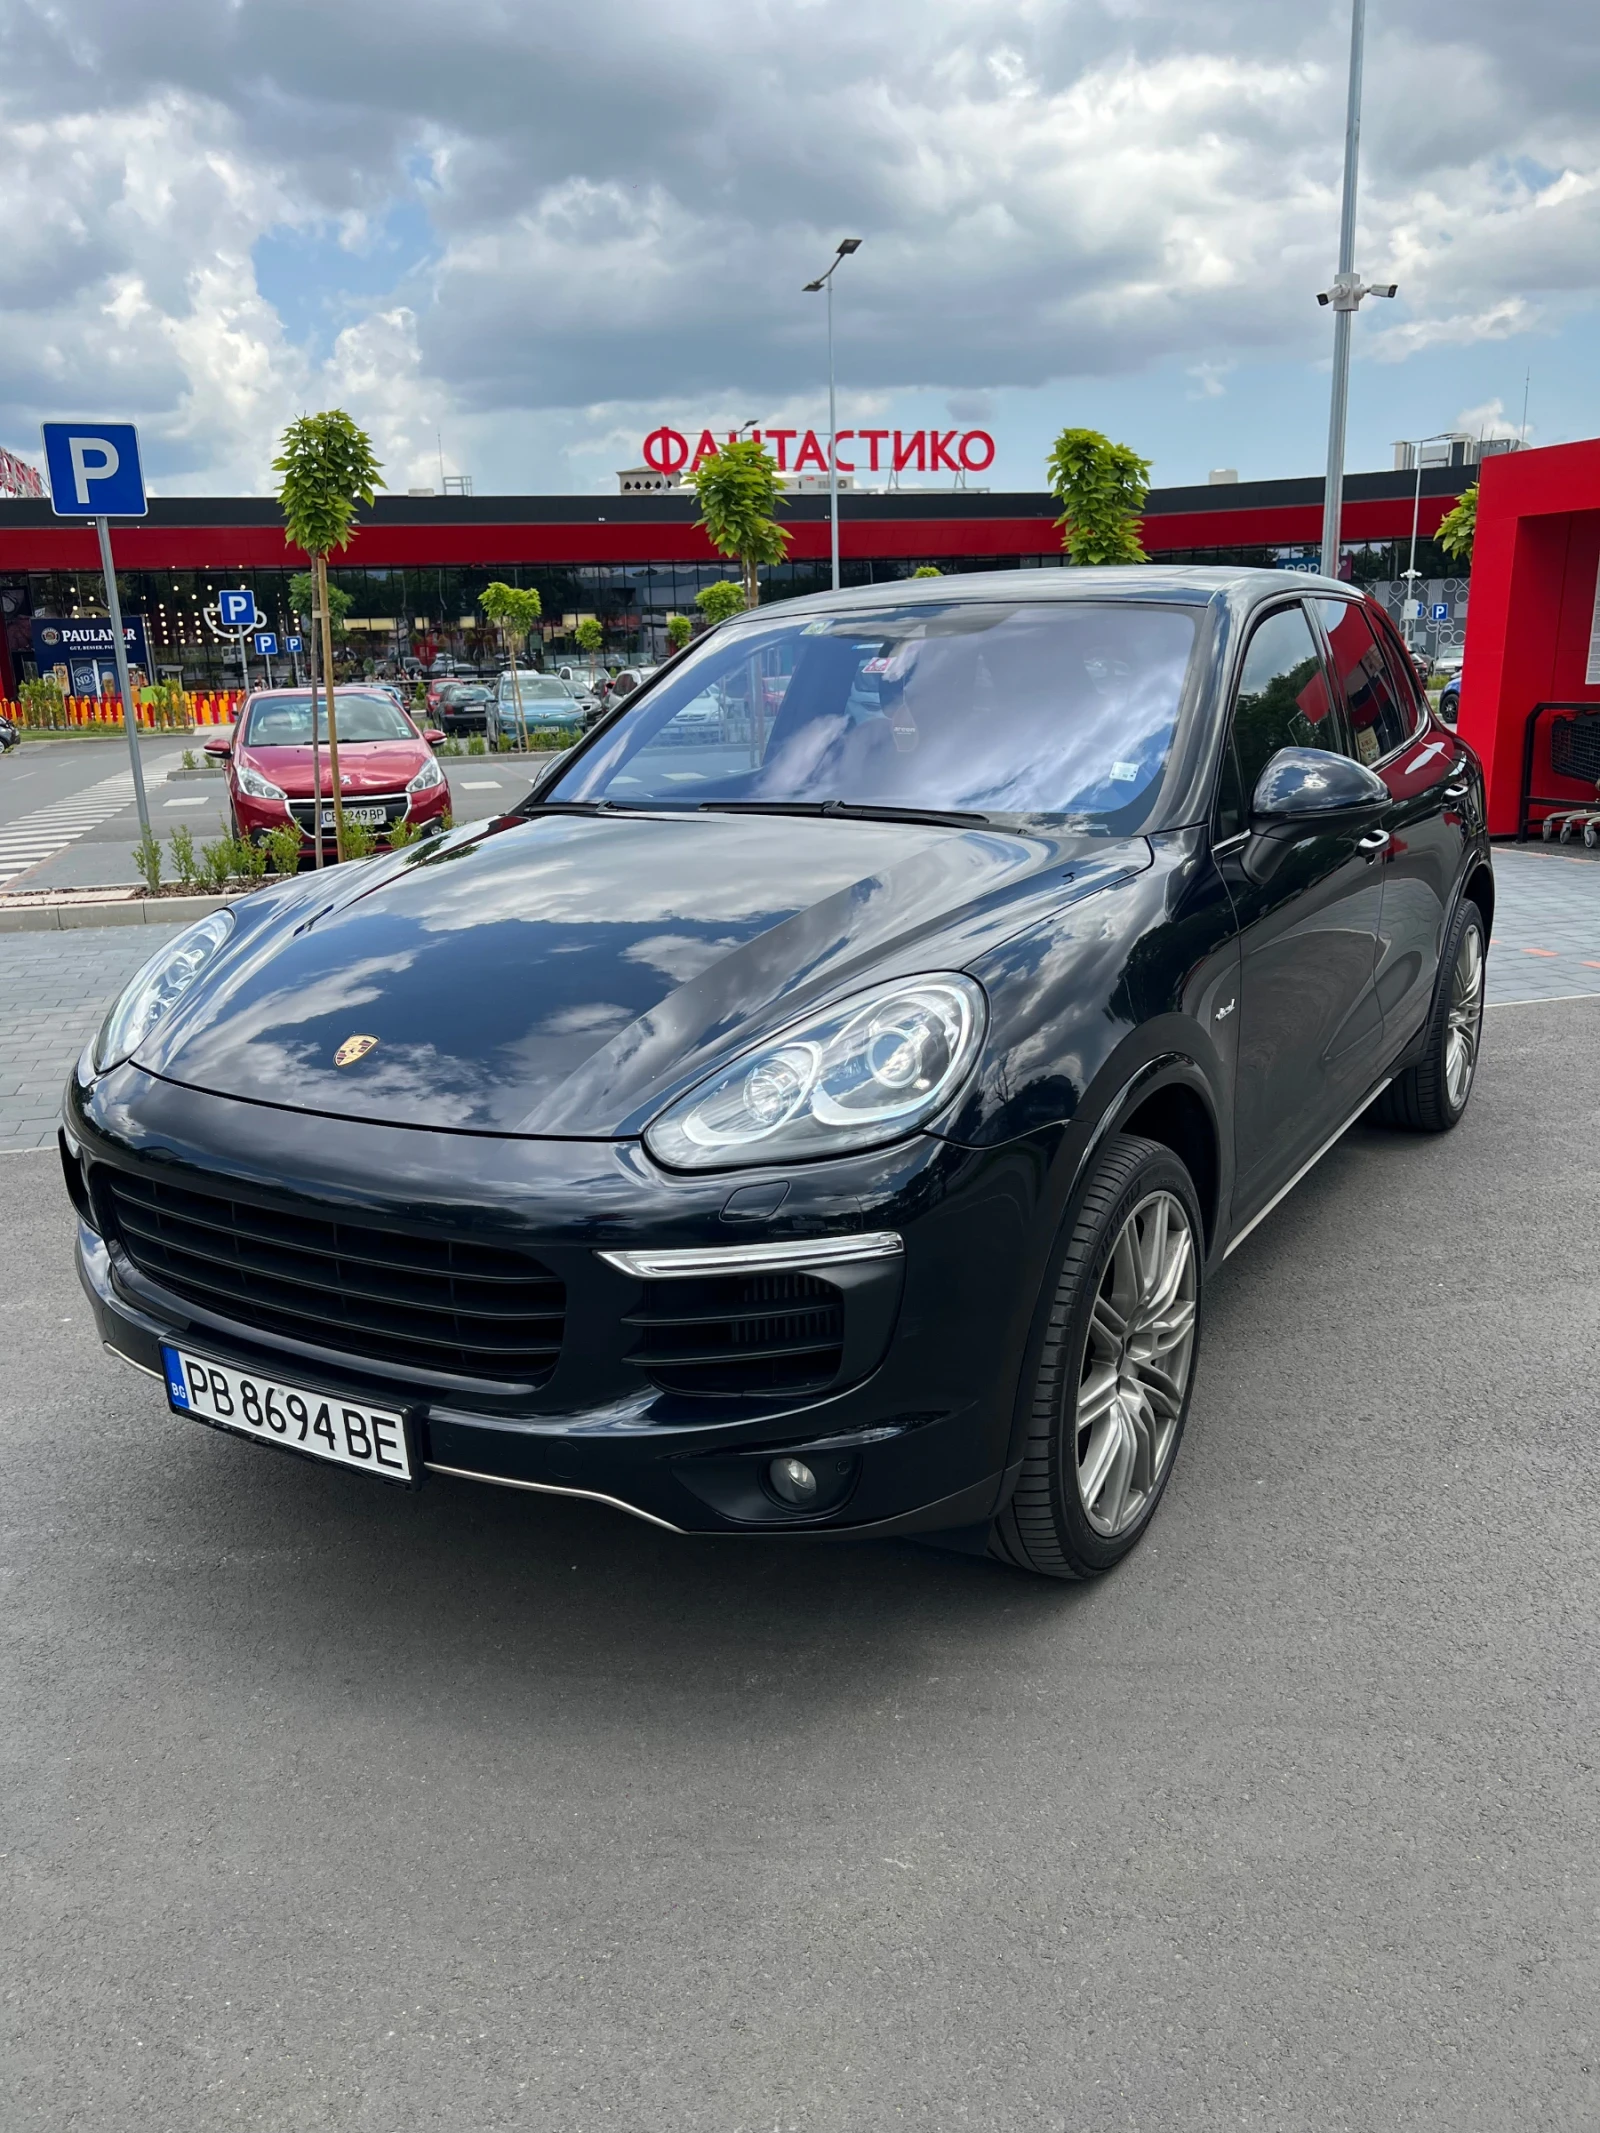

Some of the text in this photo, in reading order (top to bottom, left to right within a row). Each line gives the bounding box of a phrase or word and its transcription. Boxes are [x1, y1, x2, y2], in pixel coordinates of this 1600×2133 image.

[68, 437, 120, 504] P
[228, 596, 247, 621] P
[1435, 605, 1445, 619] P
[260, 636, 272, 652] P
[289, 638, 299, 650] P
[369, 808, 384, 820] BP
[171, 1382, 186, 1399] BG
[185, 1360, 403, 1470] PB 8694 BE
